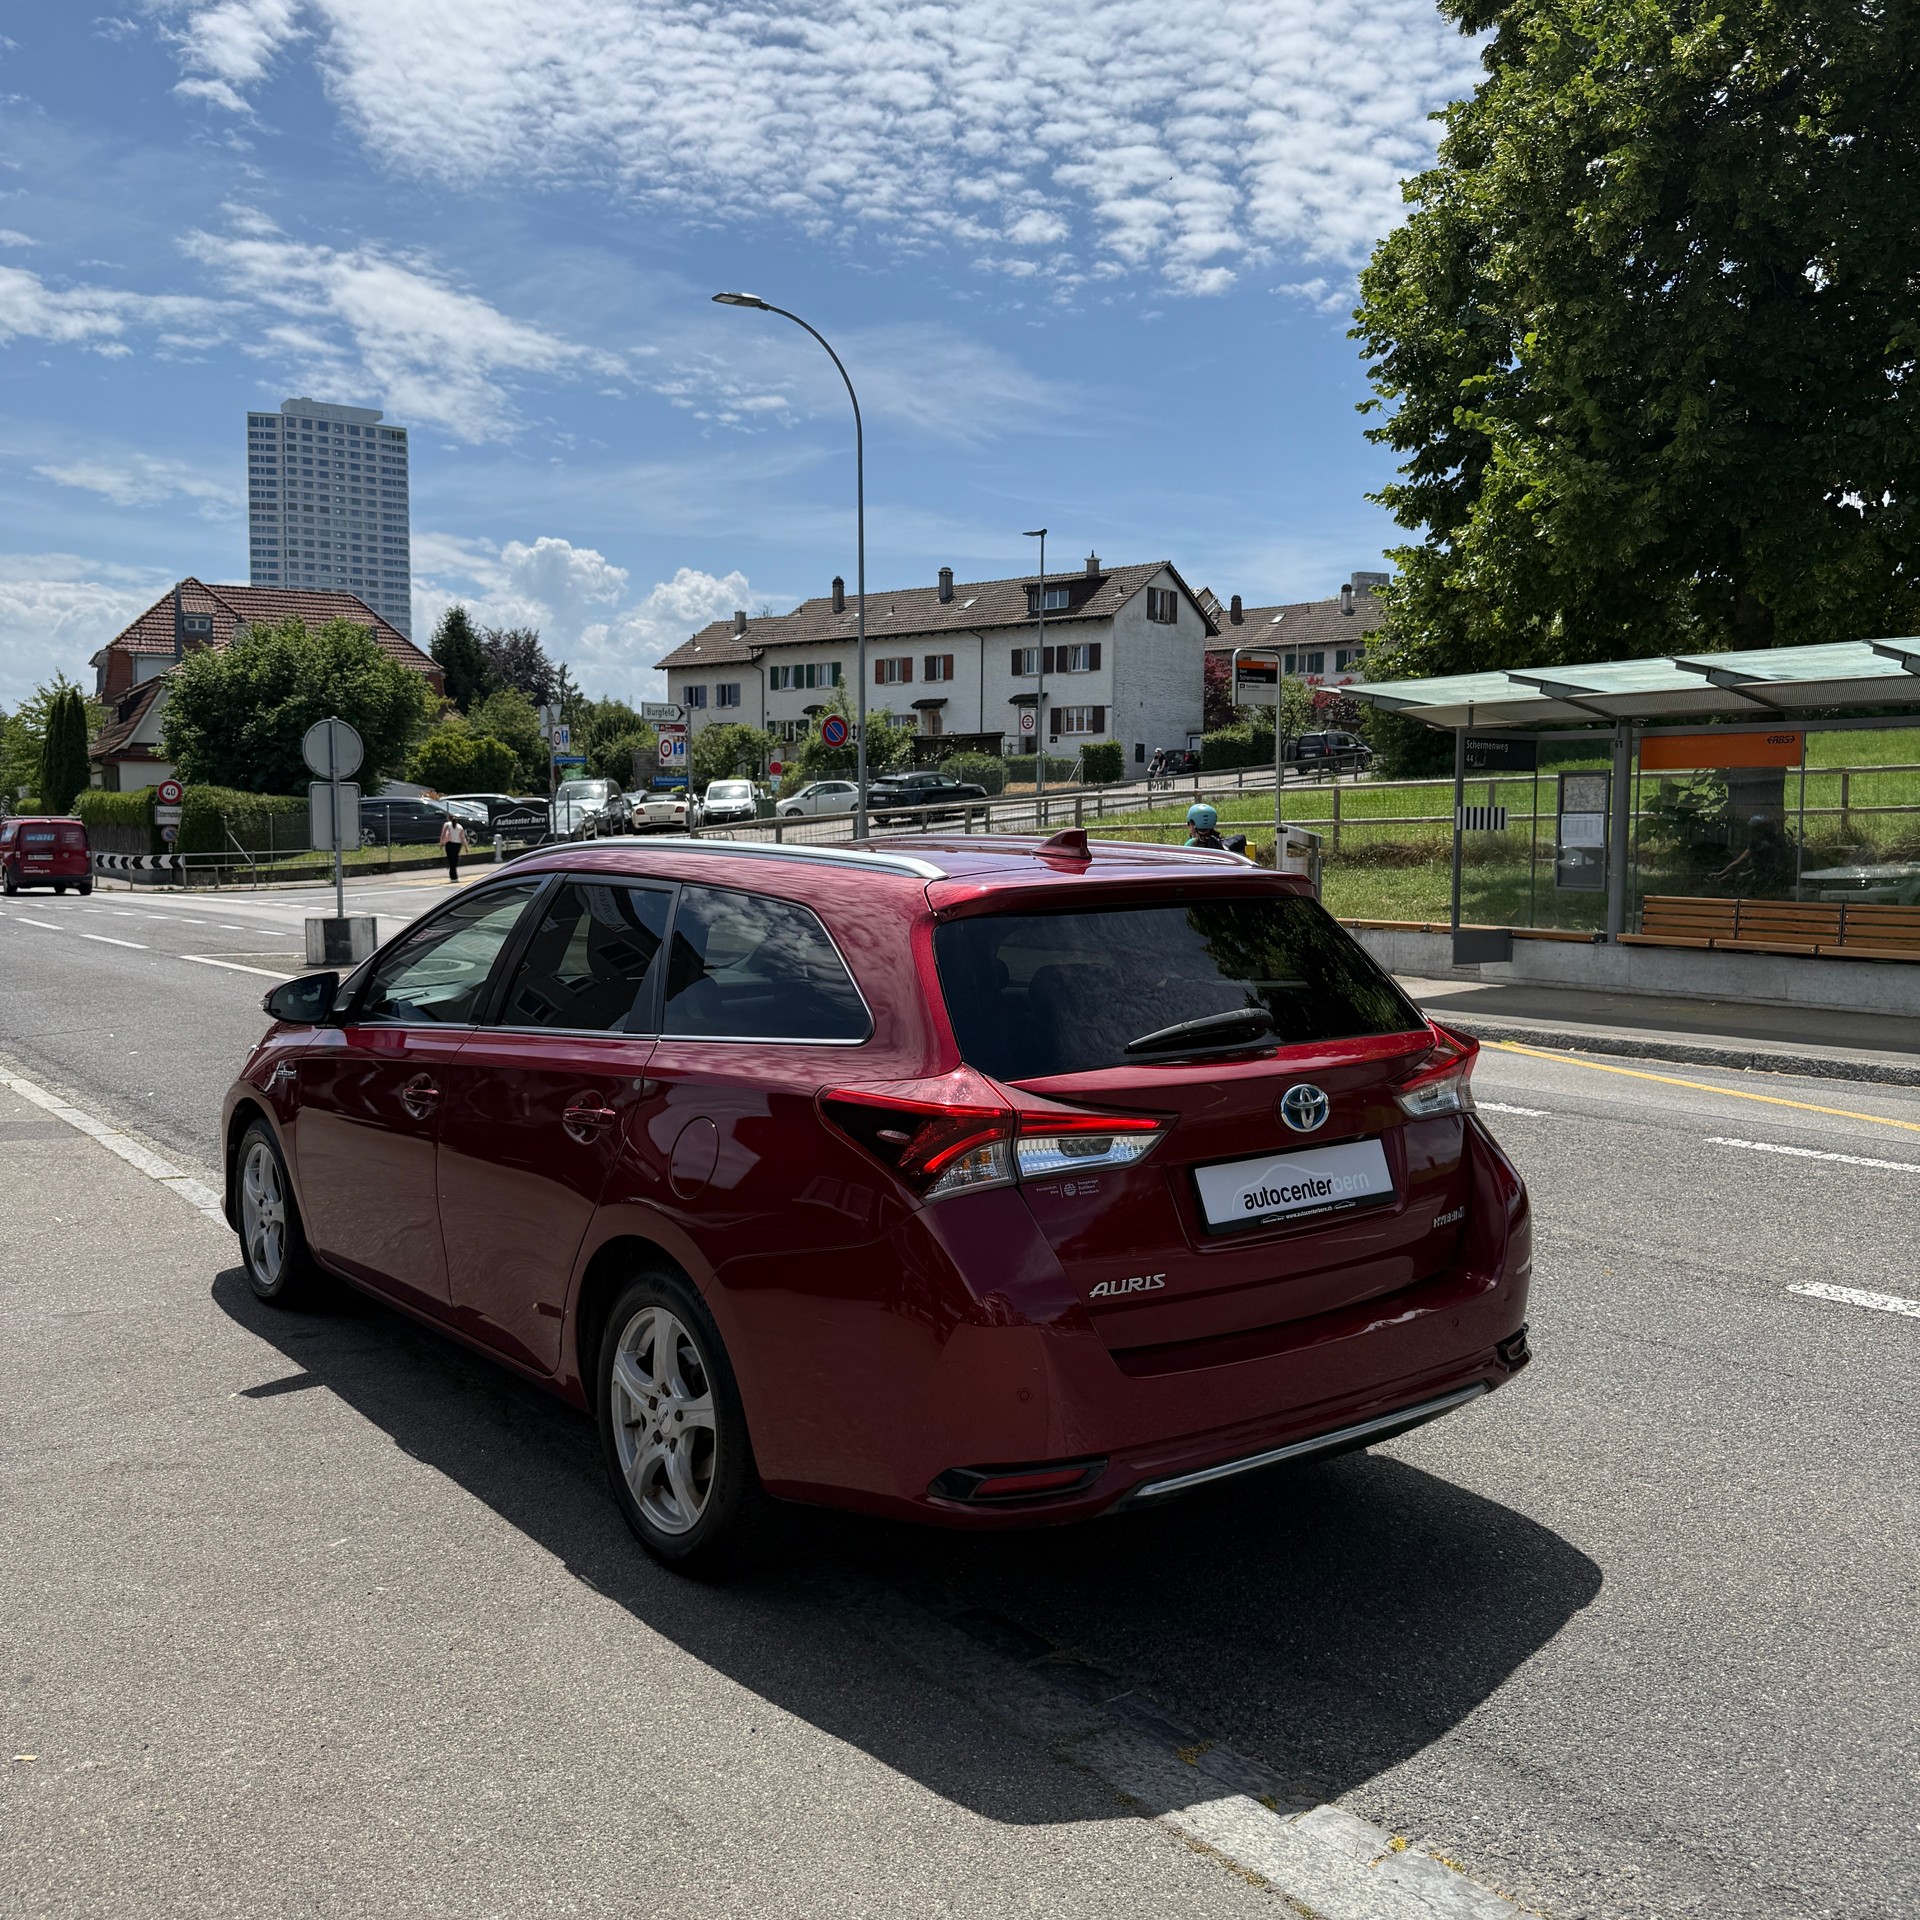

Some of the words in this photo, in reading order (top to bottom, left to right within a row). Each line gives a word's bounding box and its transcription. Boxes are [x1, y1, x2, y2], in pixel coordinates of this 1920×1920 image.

[647, 707, 674, 718] Burgfeld
[1466, 740, 1508, 753] Schermenweg
[1466, 754, 1474, 762] 44
[166, 788, 176, 796] 40
[496, 818, 531, 826] Autocenter
[531, 816, 546, 824] Bern
[1088, 1273, 1166, 1298] AURIS
